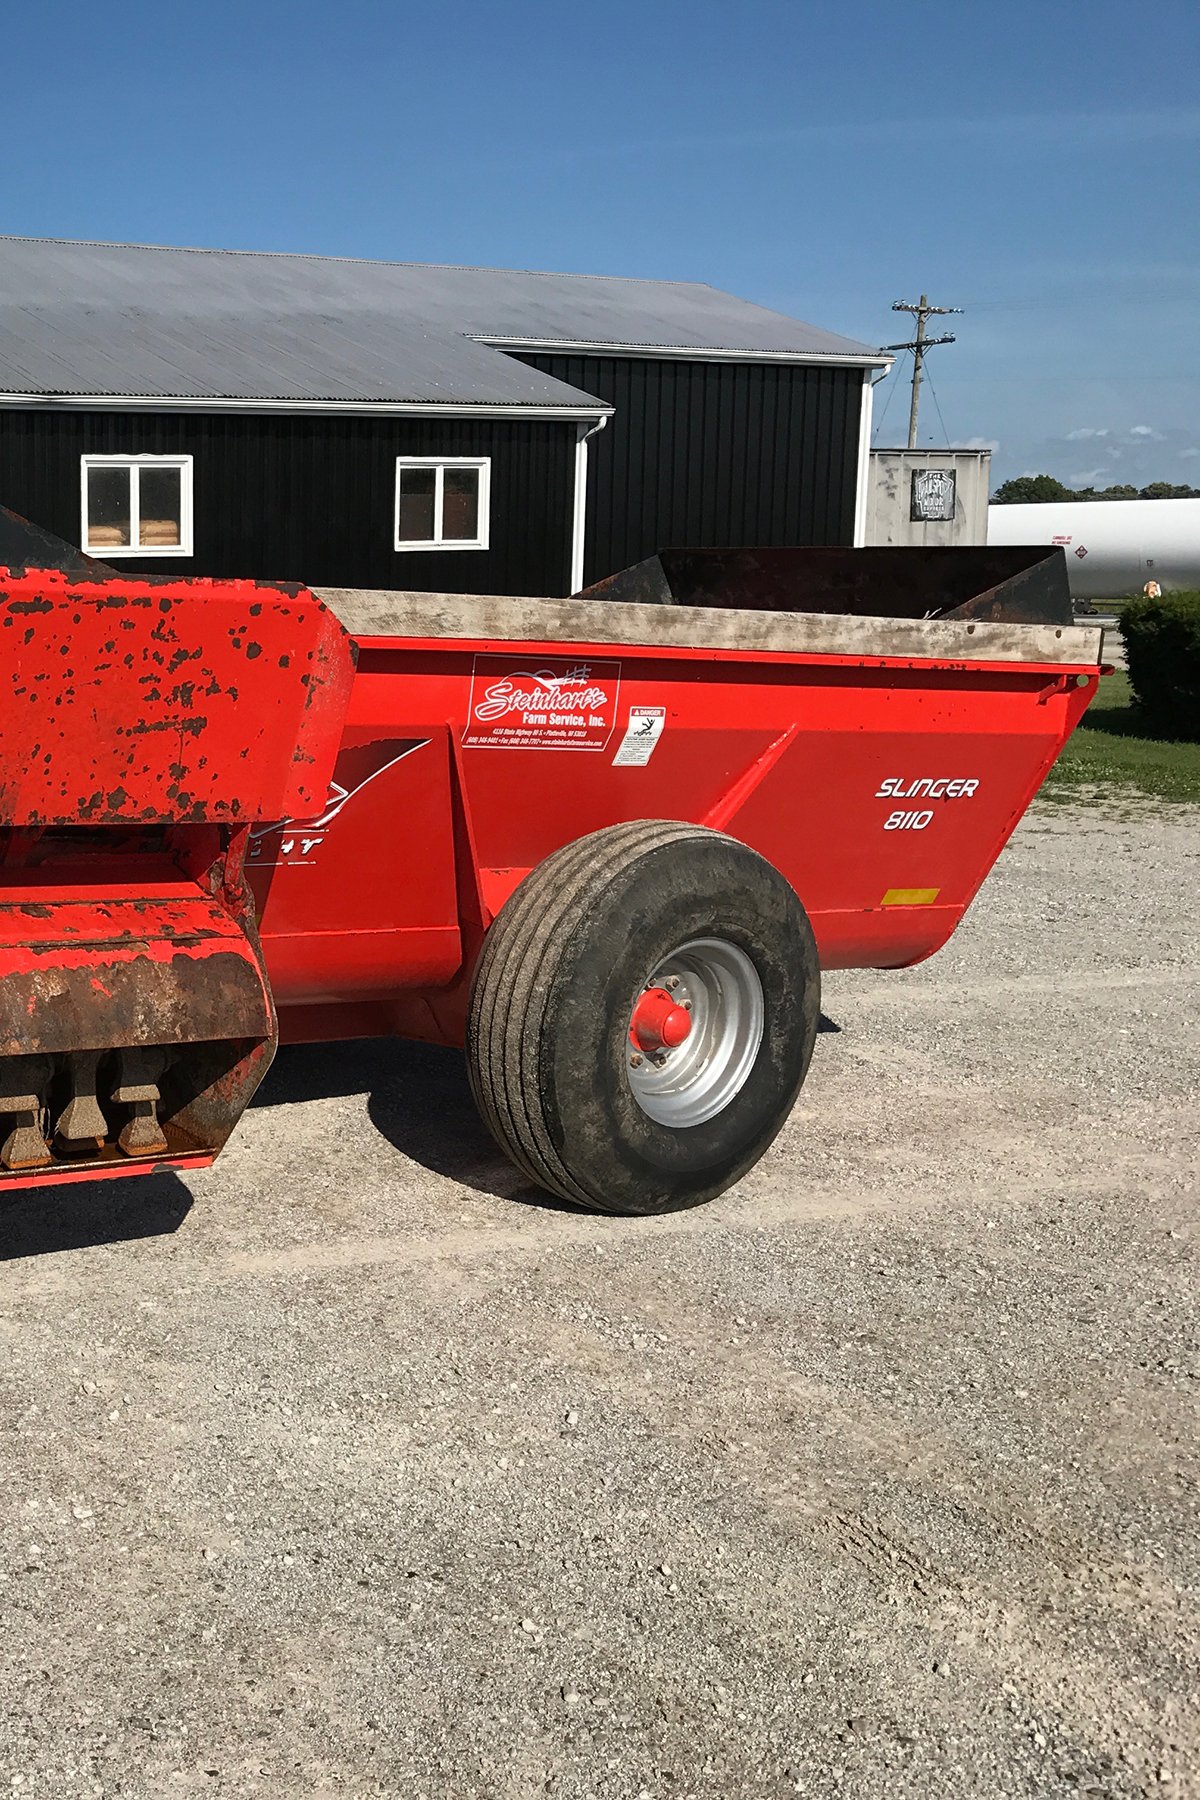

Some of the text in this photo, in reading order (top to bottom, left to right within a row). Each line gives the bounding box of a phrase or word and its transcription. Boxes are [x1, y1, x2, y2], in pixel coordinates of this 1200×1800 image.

[474, 682, 608, 721] Steinhart's
[522, 712, 606, 727] Farm Service, Inc.
[875, 778, 979, 797] SLINGER
[883, 810, 934, 830] 8110
